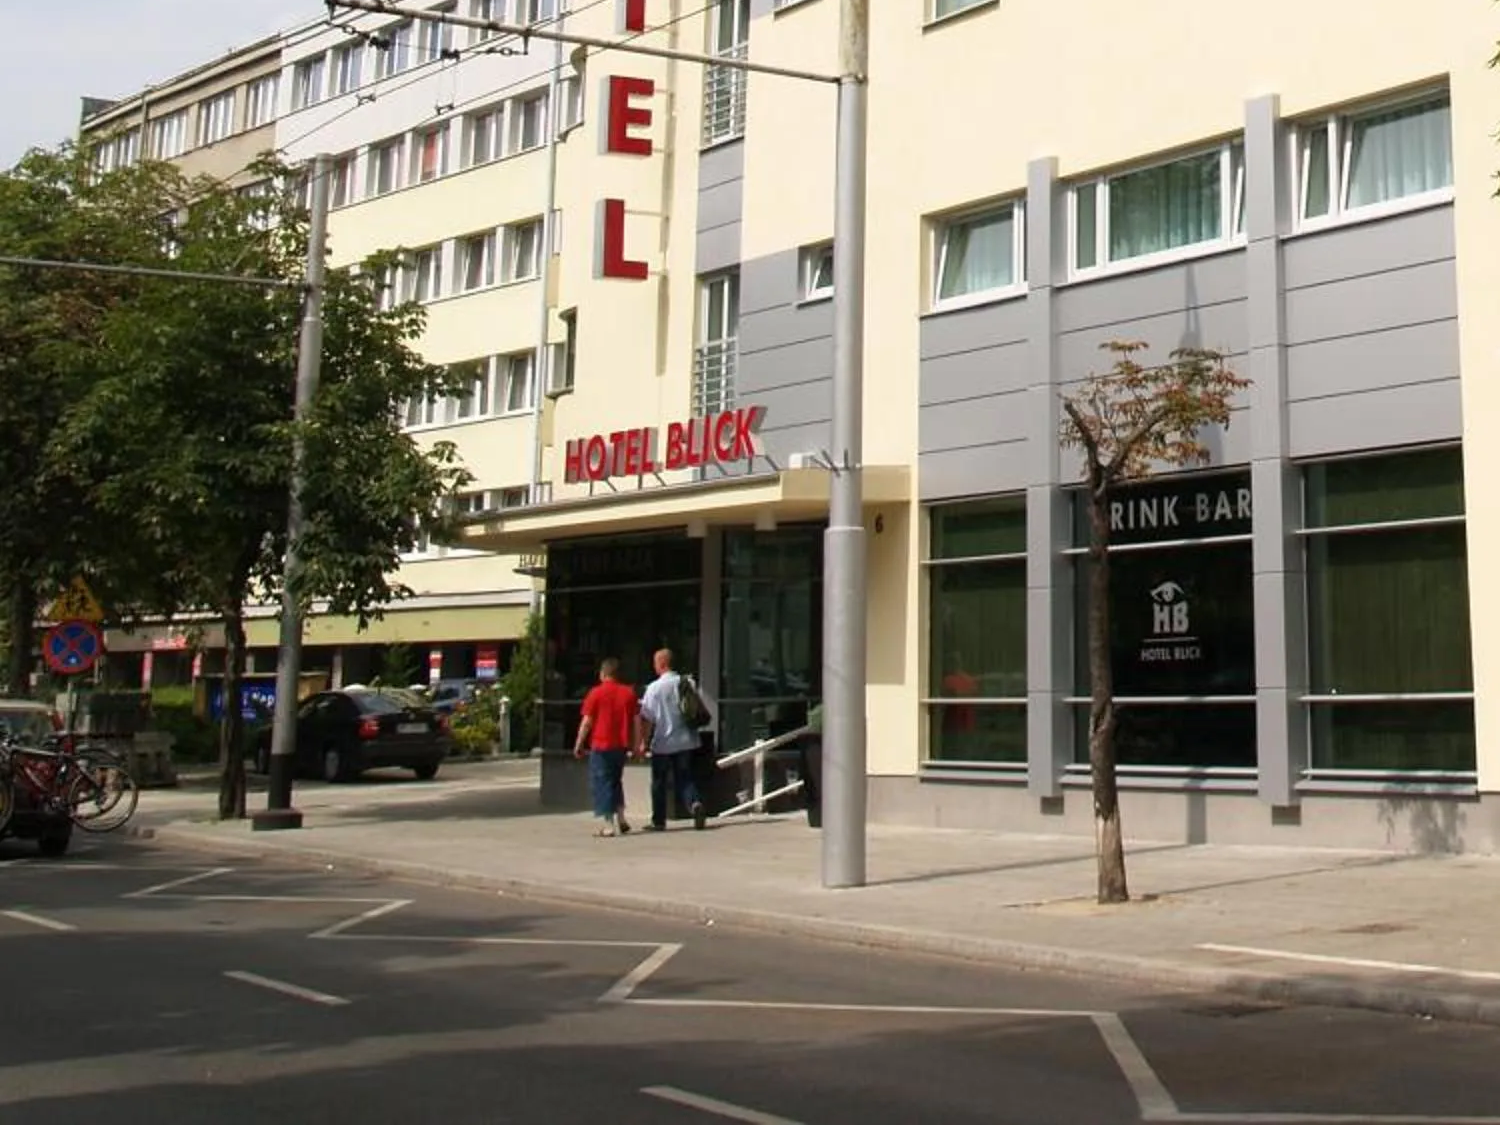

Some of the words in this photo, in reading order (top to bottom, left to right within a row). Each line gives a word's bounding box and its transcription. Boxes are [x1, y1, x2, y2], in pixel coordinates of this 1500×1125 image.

[564, 427, 658, 484] HOTEL
[666, 406, 764, 470] BLICK
[875, 513, 884, 534] 6
[1110, 494, 1180, 532] RINK
[1195, 487, 1251, 524] BAR
[1152, 600, 1190, 635] HB
[1141, 647, 1171, 662] HOTEL
